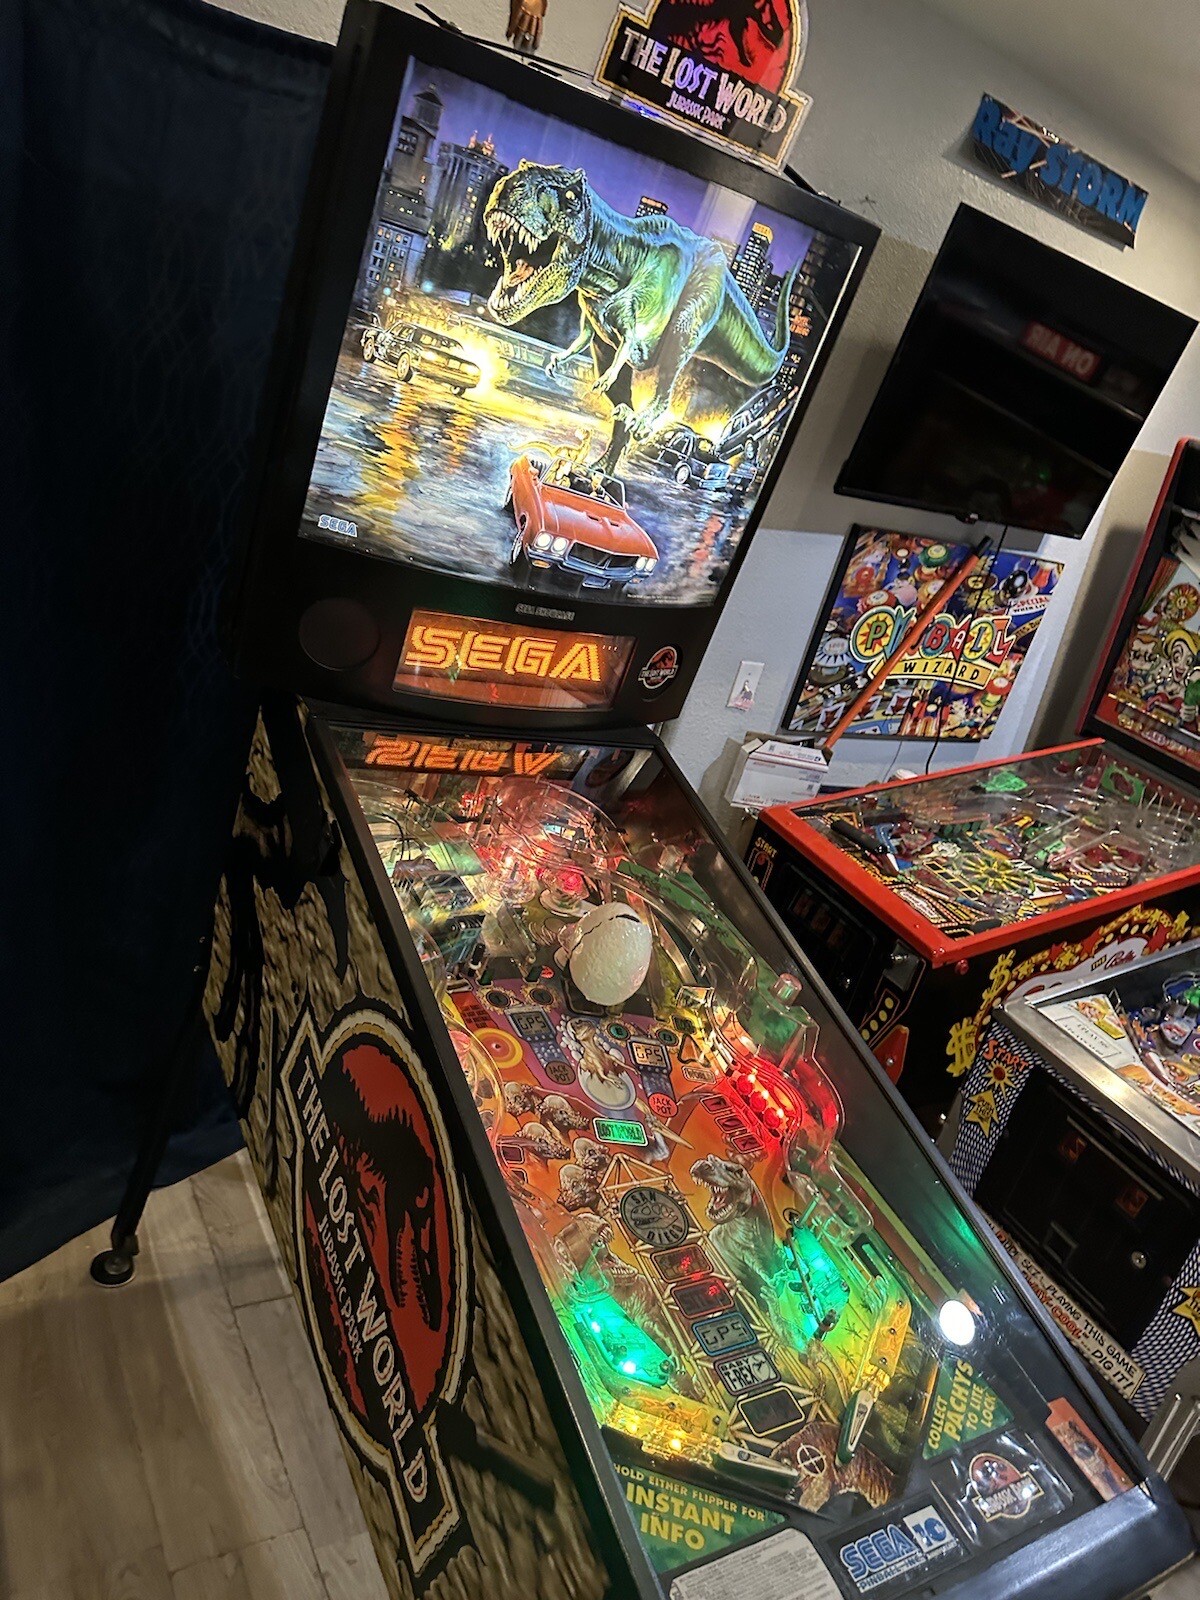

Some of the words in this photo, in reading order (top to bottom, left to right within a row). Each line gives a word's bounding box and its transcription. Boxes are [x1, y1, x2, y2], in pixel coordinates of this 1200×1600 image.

[620, 27, 668, 76] THE
[662, 47, 718, 100] LOST
[714, 73, 788, 133] WORLD
[666, 90, 704, 122] JURASSIC
[701, 106, 726, 130] PARK
[319, 513, 359, 538] SEGA
[405, 624, 601, 682] SEGA
[903, 660, 980, 682] WIZARD
[519, 1014, 547, 1030] GPS
[549, 1064, 567, 1075] JACK
[636, 1047, 664, 1064] GPS
[982, 1040, 1029, 1072] START
[554, 1072, 570, 1082] POT
[652, 1096, 671, 1107] JACK
[655, 1104, 672, 1116] POT
[647, 1224, 683, 1244] DIEGO
[298, 1054, 327, 1163] THE
[317, 1144, 365, 1274] LOST
[353, 1268, 429, 1502] WORLD
[317, 1213, 347, 1298] JURASSIC
[338, 1294, 361, 1364] PARK
[701, 1321, 749, 1345] GPS
[1047, 1284, 1082, 1321] PLAYING
[1084, 1320, 1105, 1346] THIS
[1107, 1345, 1137, 1377] GAME
[720, 1356, 749, 1371] BABY
[723, 1364, 760, 1390] T-REX
[1092, 1349, 1114, 1370] DIG
[1113, 1370, 1134, 1389] IT!
[944, 1359, 974, 1442] PACHYS
[969, 1383, 986, 1411] LITE
[981, 1394, 996, 1427] LOCK
[928, 1395, 948, 1450] COLLECT
[965, 1411, 979, 1431] TO
[614, 1464, 645, 1483] HOLD
[648, 1475, 688, 1495] EITHER
[692, 1490, 738, 1513] FLIPPER
[741, 1505, 765, 1522] FOR
[625, 1482, 735, 1535] INSTANT
[640, 1513, 706, 1550] INFO
[839, 1523, 919, 1582] SEGA
